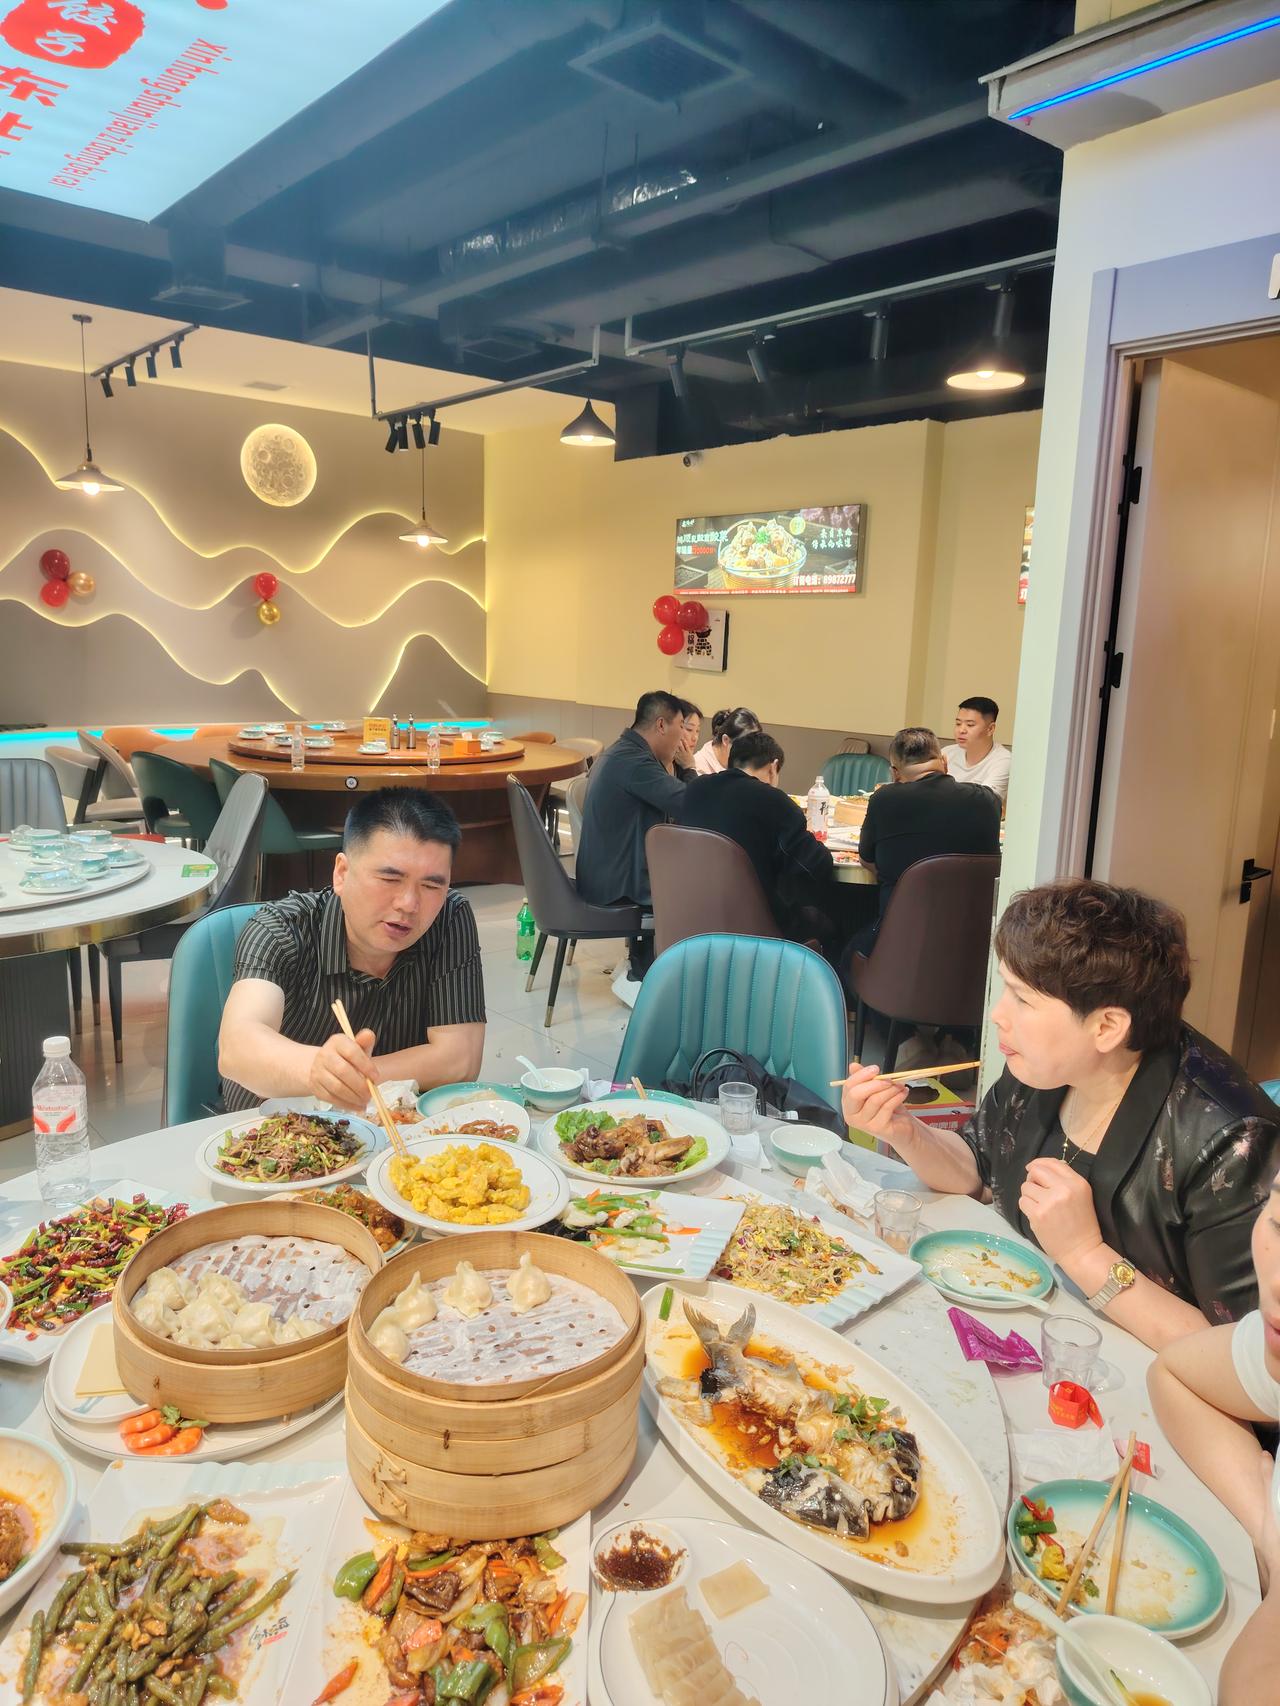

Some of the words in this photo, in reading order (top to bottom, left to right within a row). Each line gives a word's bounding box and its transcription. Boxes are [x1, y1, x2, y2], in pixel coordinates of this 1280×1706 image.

[181, 37, 232, 64] xin
[139, 59, 219, 94] hong
[123, 89, 182, 118] shun
[105, 110, 159, 136] jiao
[63, 141, 128, 166] dong
